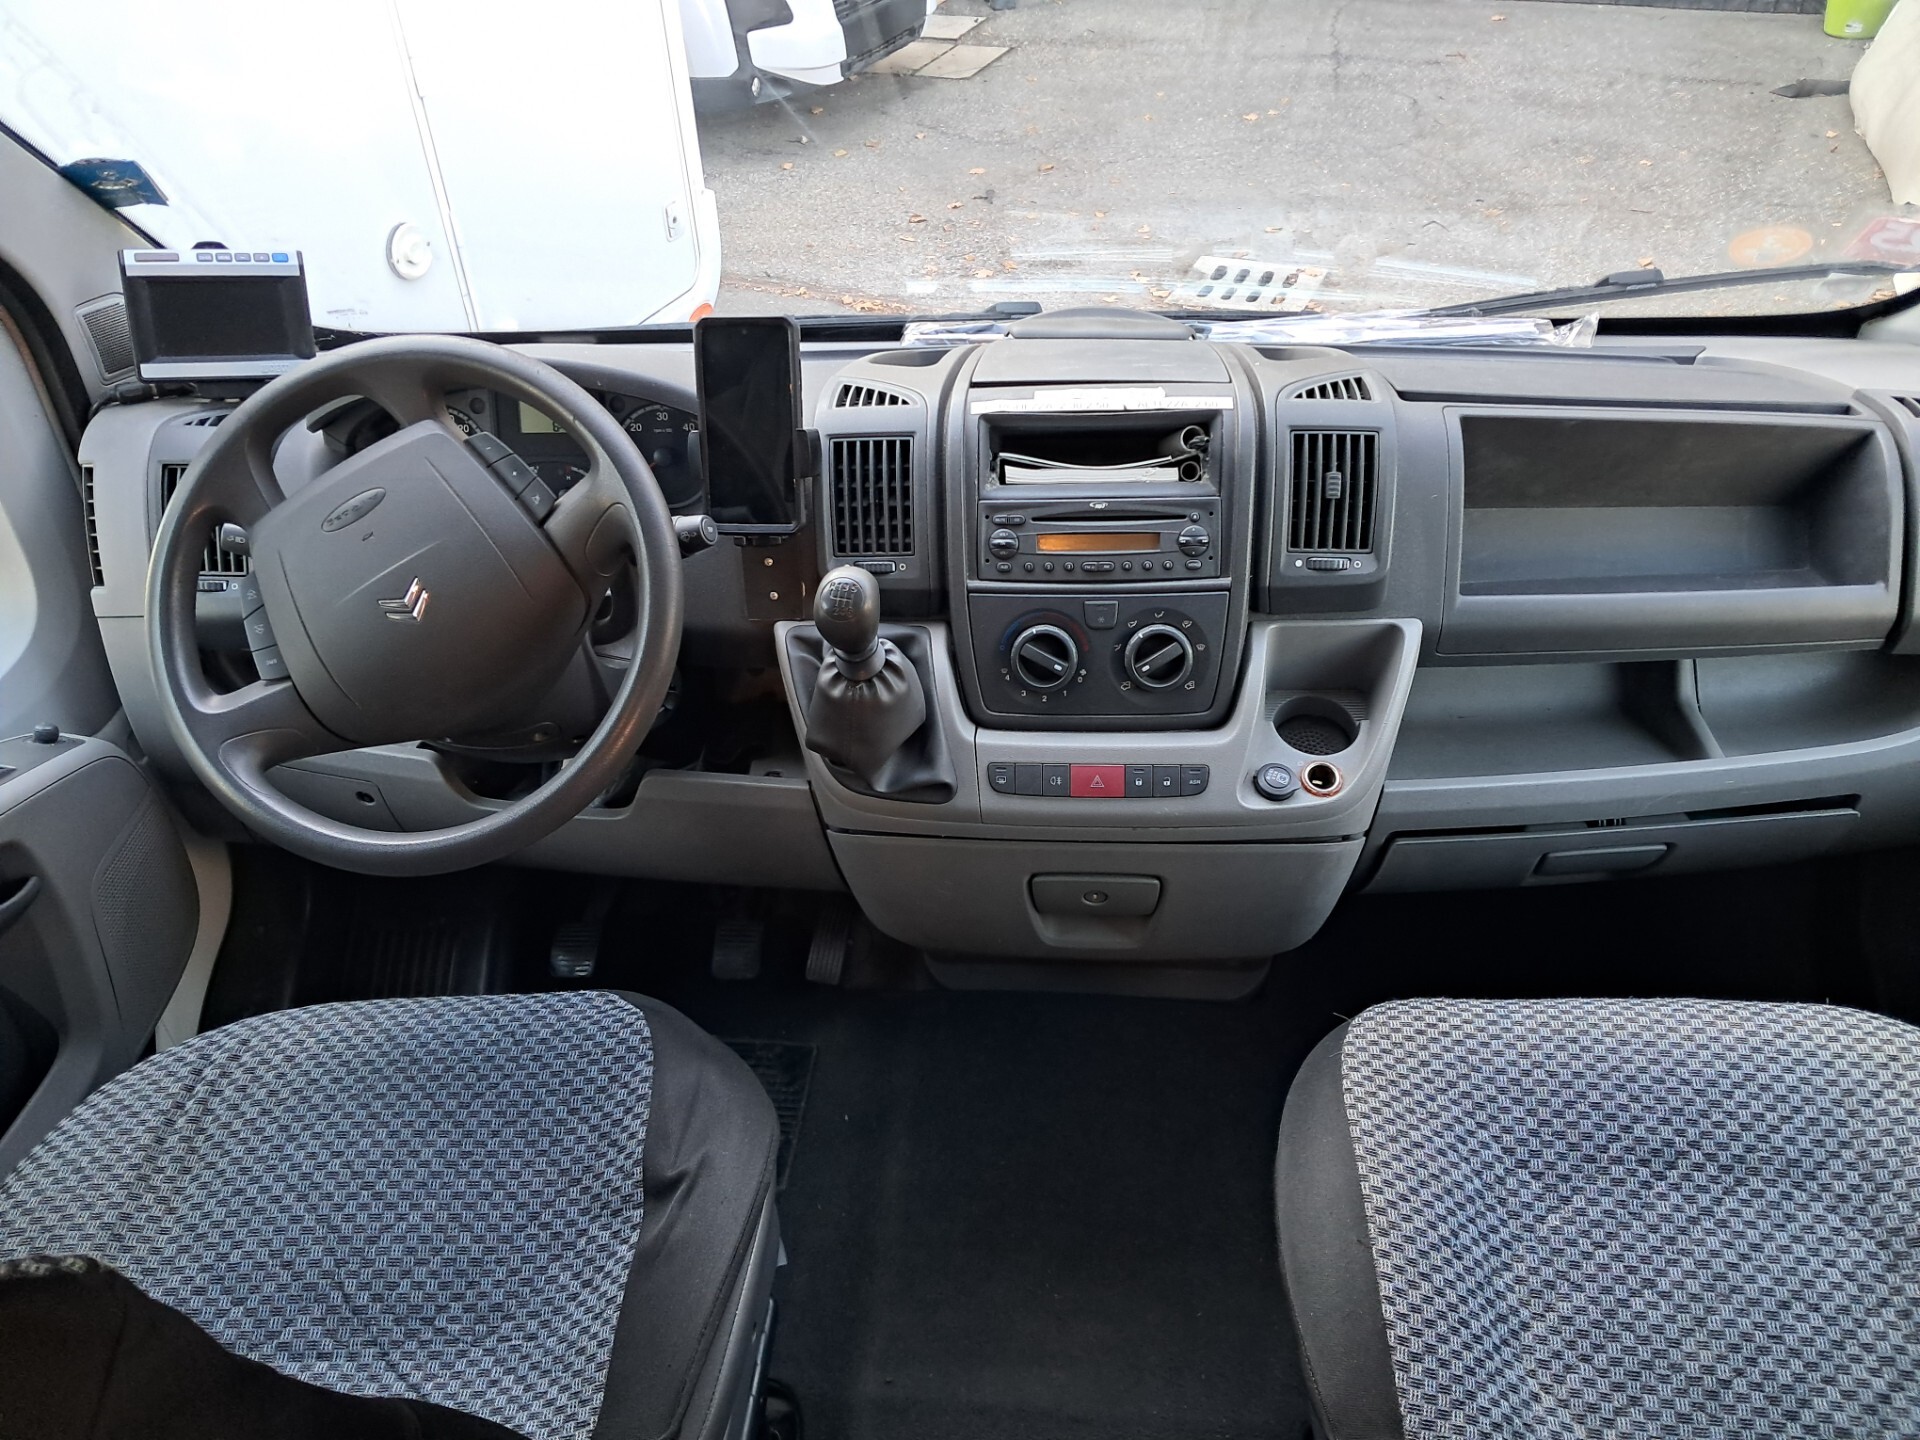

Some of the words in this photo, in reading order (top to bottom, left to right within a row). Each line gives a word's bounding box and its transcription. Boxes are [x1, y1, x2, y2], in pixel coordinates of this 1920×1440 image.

[657, 412, 668, 421] 30
[630, 423, 642, 432] 20
[683, 423, 695, 432] 40
